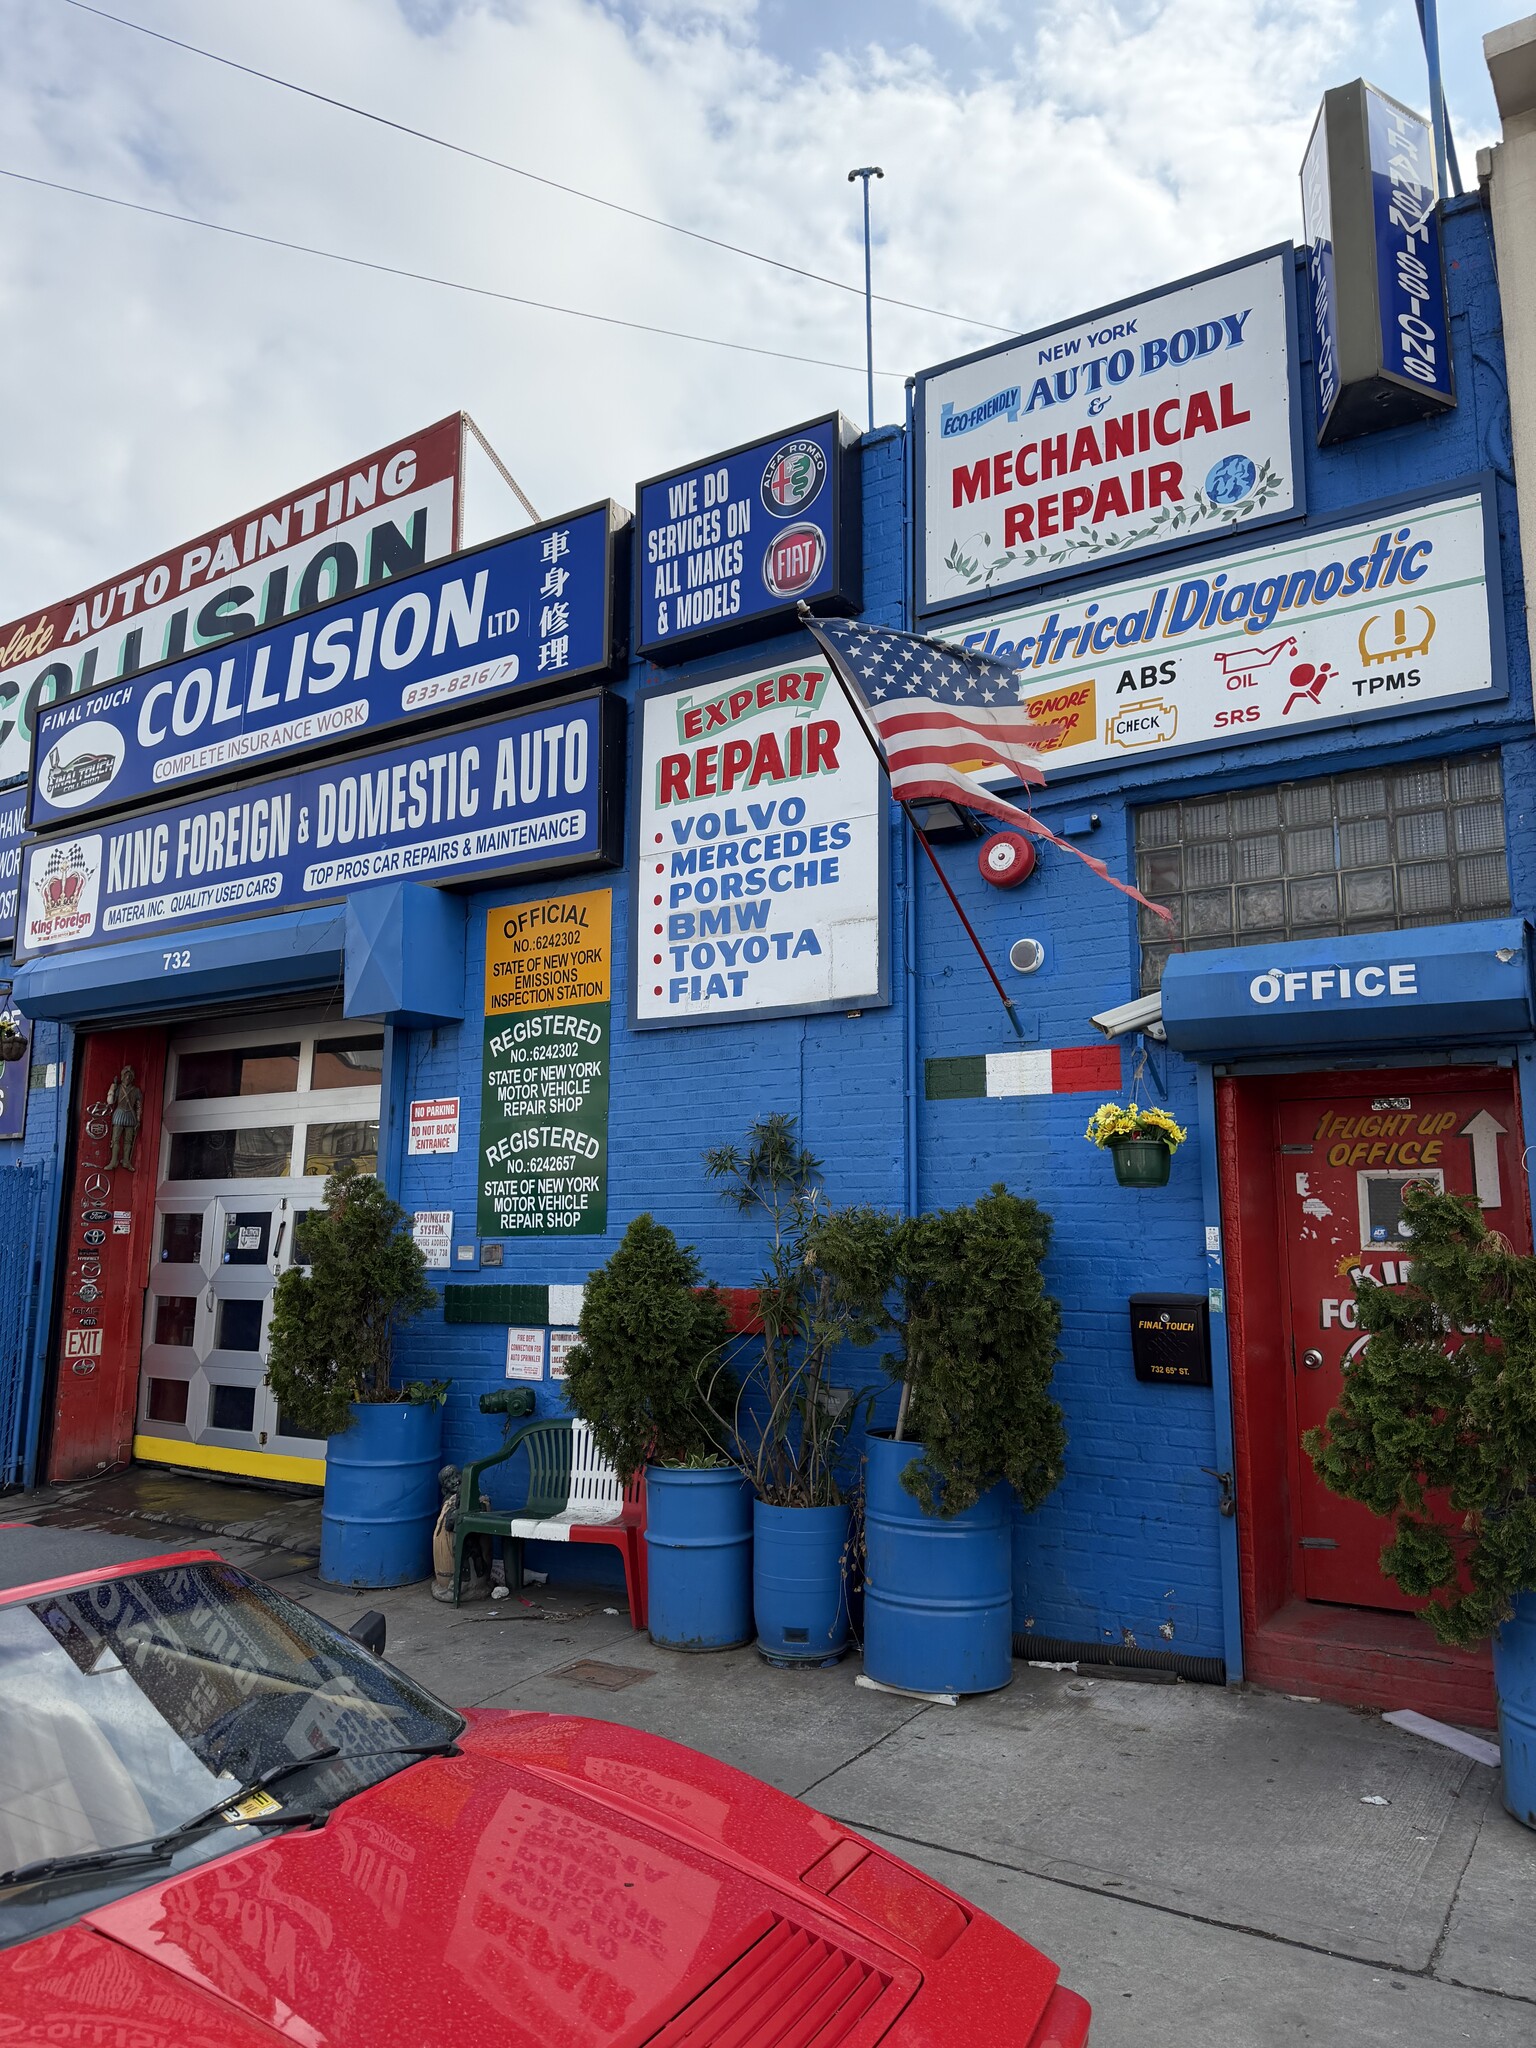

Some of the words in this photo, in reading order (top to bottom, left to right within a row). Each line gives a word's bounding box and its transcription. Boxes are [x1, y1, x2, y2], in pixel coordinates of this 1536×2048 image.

[1038, 338, 1081, 366] NEW
[1087, 318, 1138, 350] YORK
[1021, 349, 1135, 416] AUTO
[1139, 308, 1253, 378] BODY
[943, 388, 1018, 436] ECO-FRIENDLY
[1087, 395, 1112, 417] &
[952, 382, 1251, 508] MECHANICAL
[764, 454, 784, 488] ALFA
[789, 443, 824, 470] ROMEO
[669, 479, 697, 520] WE
[704, 468, 728, 508] DO
[1004, 460, 1184, 548] REPAIR
[648, 509, 721, 564] SERVICES
[728, 499, 750, 538] ON
[0, 614, 54, 669] lete
[63, 566, 170, 642] AUTO
[179, 449, 417, 591] PAINTING
[655, 562, 681, 599] ALL
[687, 540, 743, 589] MAKES
[778, 541, 812, 581] FIAT
[1165, 528, 1434, 635] Diagnostic
[538, 530, 570, 672] 車身修理
[657, 601, 669, 635] &
[676, 579, 740, 630] MODELS
[137, 569, 489, 747] COLLISION
[488, 608, 520, 638] LTD
[406, 661, 513, 705] 833-8216/7
[1116, 660, 1177, 694] ABS
[1225, 673, 1259, 691] OIL
[1352, 669, 1422, 697] TPMS
[41, 707, 82, 733] FINAL
[86, 686, 133, 715] TOUCH
[684, 672, 824, 739] EXPERT
[1213, 705, 1261, 729] SRS
[155, 745, 224, 779] COMPLETE
[227, 721, 314, 760] INSURANCE
[316, 704, 365, 734] WORK
[1116, 714, 1161, 735] CHECK
[656, 719, 840, 808] REPAIR
[107, 824, 169, 893] KING
[176, 794, 292, 879] FOREIGN
[298, 806, 309, 844] &
[316, 746, 479, 849] DOMESTIC
[493, 719, 588, 811] AUTO
[671, 797, 806, 845] VOLVO
[310, 867, 334, 886] TOP
[336, 859, 370, 882] PROS
[373, 853, 400, 874] CAR
[403, 841, 459, 870] REPAIRS
[462, 839, 472, 856] &
[475, 815, 579, 853] MAINTENANCE
[670, 821, 851, 878] MERCEDES
[669, 857, 840, 908] PORSCHE
[108, 908, 146, 926] MATERA
[147, 902, 165, 917] INC.
[171, 888, 215, 913] QUALITY
[216, 883, 244, 904] USED
[246, 877, 277, 898] CARS
[31, 920, 53, 935] King
[55, 912, 91, 930] Foreign
[503, 904, 589, 939] OFFICIAL
[668, 899, 772, 941] BMW
[513, 930, 580, 953] NO.:6242302
[669, 928, 822, 972] TOYOTA
[163, 951, 191, 970] 732
[493, 960, 524, 977] STATE
[527, 957, 541, 972] OF
[543, 954, 569, 970] NEW
[571, 948, 602, 966] YORK
[491, 987, 554, 1008] INSPECTION
[556, 981, 603, 1001] STATION
[514, 968, 578, 989] EMISSIONS
[669, 970, 749, 1004] FIAT
[1250, 964, 1418, 1004] OFFICE
[490, 1014, 601, 1058] REGISTERED
[510, 1042, 579, 1063] NO.:6242302
[488, 1068, 521, 1086] STATE
[523, 1067, 538, 1082] OF
[540, 1065, 566, 1081] NEW
[568, 1061, 601, 1078] YORK
[498, 1083, 538, 1101] MOTOR
[540, 1079, 590, 1097] VEHICLE
[415, 1107, 424, 1117] NO
[426, 1104, 455, 1116] PARKING
[503, 1100, 546, 1116] REPAIR
[549, 1097, 583, 1113] SHOP
[412, 1126, 420, 1136] DO
[422, 1125, 435, 1135] NOT
[436, 1124, 456, 1135] BLOCK
[1315, 1110, 1333, 1141] 1
[1328, 1114, 1417, 1139] FLIGHT
[1418, 1111, 1457, 1135] UP
[416, 1138, 450, 1149] ENTRANCE
[485, 1126, 599, 1167] REGISTERED
[1329, 1140, 1443, 1167] OFFICE
[507, 1155, 576, 1173] NO.:6242657
[484, 1181, 517, 1196] STATE
[520, 1180, 534, 1194] OF
[536, 1178, 565, 1194] NEW
[567, 1176, 599, 1192] YORK
[416, 1213, 450, 1223] SPRINKLER
[494, 1197, 536, 1212] MOTOR
[538, 1195, 588, 1210] VEHICLE
[500, 1213, 543, 1229] REPAIR
[547, 1212, 581, 1227] SHOP
[420, 1225, 443, 1235] SYSTEM
[431, 1239, 448, 1247] ADDRESS
[68, 1331, 100, 1355] EXIT
[1139, 1321, 1163, 1329] FINAL
[1166, 1322, 1194, 1331] TOUCH
[511, 1344, 533, 1352] CONNECTION
[520, 1354, 540, 1362] SPRINKLER
[1151, 1366, 1164, 1374] 732
